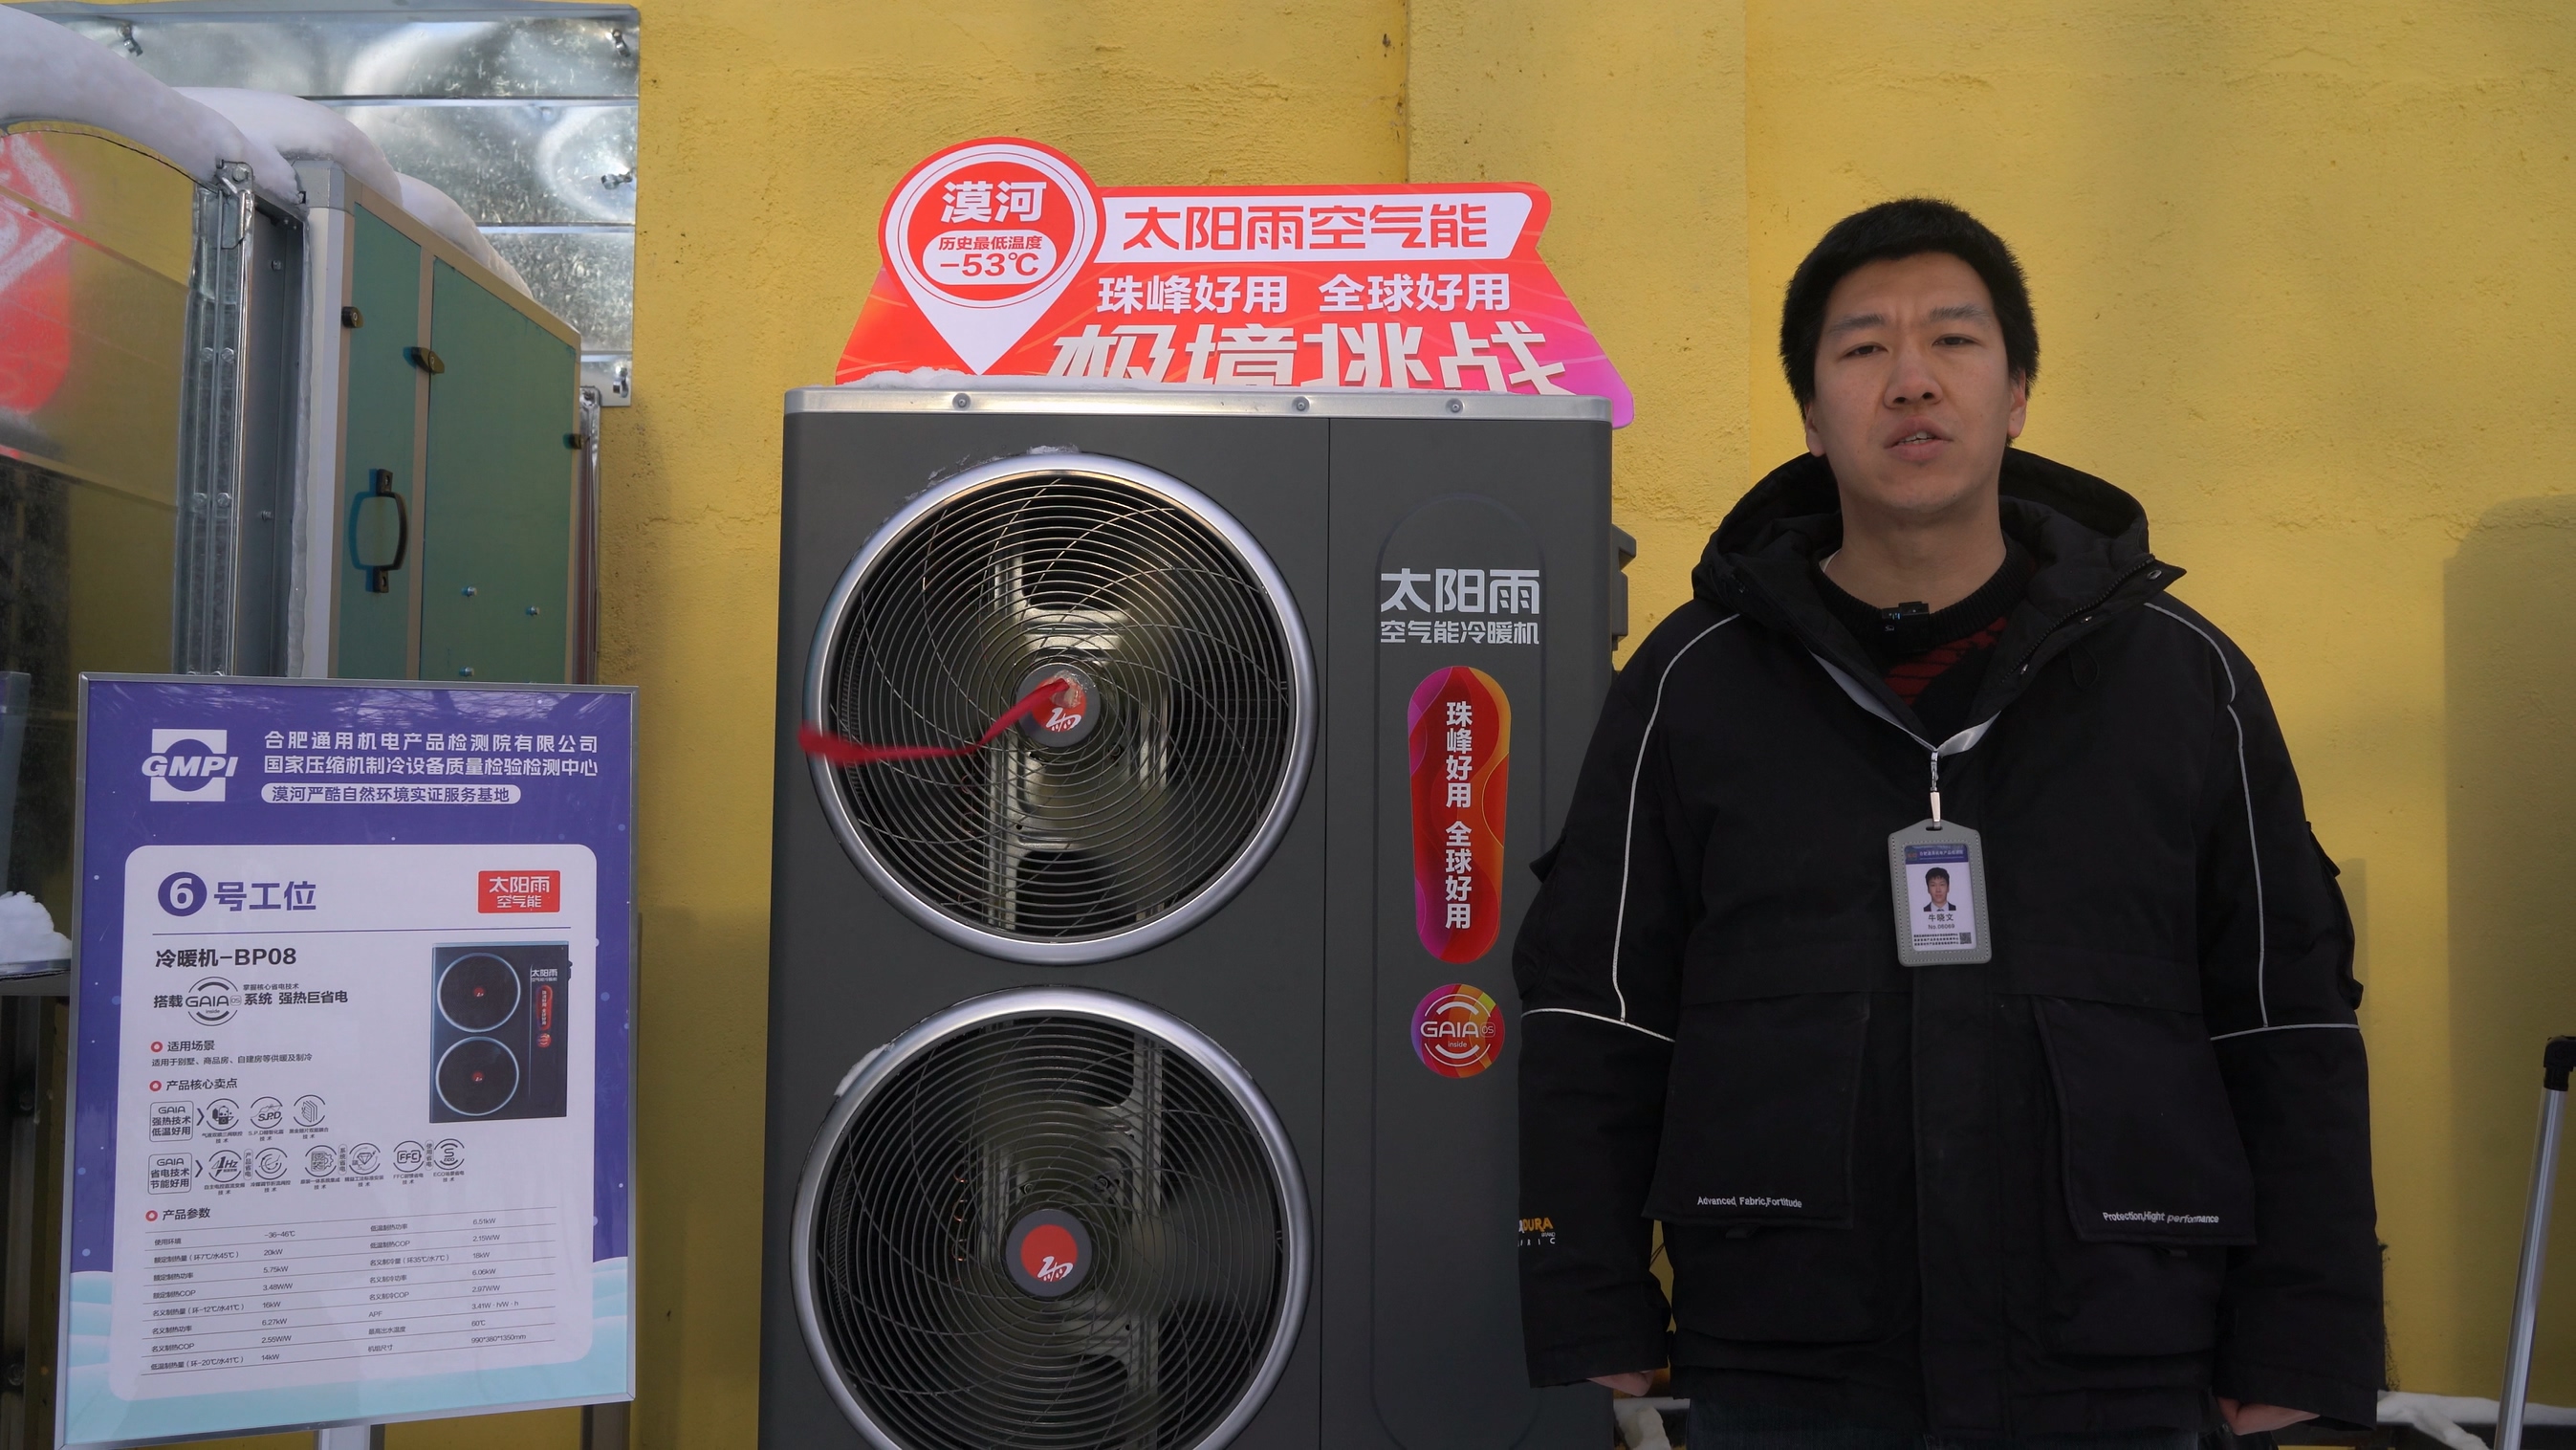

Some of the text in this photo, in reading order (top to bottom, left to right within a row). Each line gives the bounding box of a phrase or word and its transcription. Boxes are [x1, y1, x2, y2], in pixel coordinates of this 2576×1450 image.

[941, 180, 1047, 223] 漠河
[1123, 203, 1488, 252] 太阳雨空气能
[938, 235, 1042, 251] 历史最低温度
[1097, 274, 1512, 315] 珠峰好用 全球好用
[1381, 568, 1539, 614] 太阳雨
[1381, 620, 1539, 645] 空气能冷暖机
[264, 731, 598, 754] 合肥通用机电产品检测院有限公司
[142, 756, 238, 778] GMPI
[264, 755, 599, 777] 国家压缩机制冷设备质量检验检测中心
[272, 786, 510, 802] 漠河严酷自然环境实证服务基地
[1445, 701, 1473, 929] 珠峰好用 全球好用
[489, 876, 550, 893] 太阳雨
[169, 877, 317, 912] 6 号工位
[496, 895, 542, 909] 空气能
[153, 994, 183, 1008] 搭载
[186, 996, 229, 1007] GAIA
[244, 993, 273, 1005] 系统
[278, 990, 348, 1004] 强热巨省电
[1420, 1021, 1494, 1038] GAIA OS
[167, 1040, 215, 1052] 适用场景
[151, 1053, 313, 1066] 适用于别墅、商品房、自建房等供暖及制冷
[165, 1078, 238, 1091] 产品核心卖点
[158, 1106, 186, 1114] GAIA
[151, 1116, 191, 1126] 强热技术
[151, 1126, 191, 1137] 低温好用
[156, 1158, 185, 1167] GAIA
[150, 1168, 190, 1178] 省电技术
[149, 1177, 189, 1190] 节能好用
[163, 1207, 210, 1220] 产品参数
